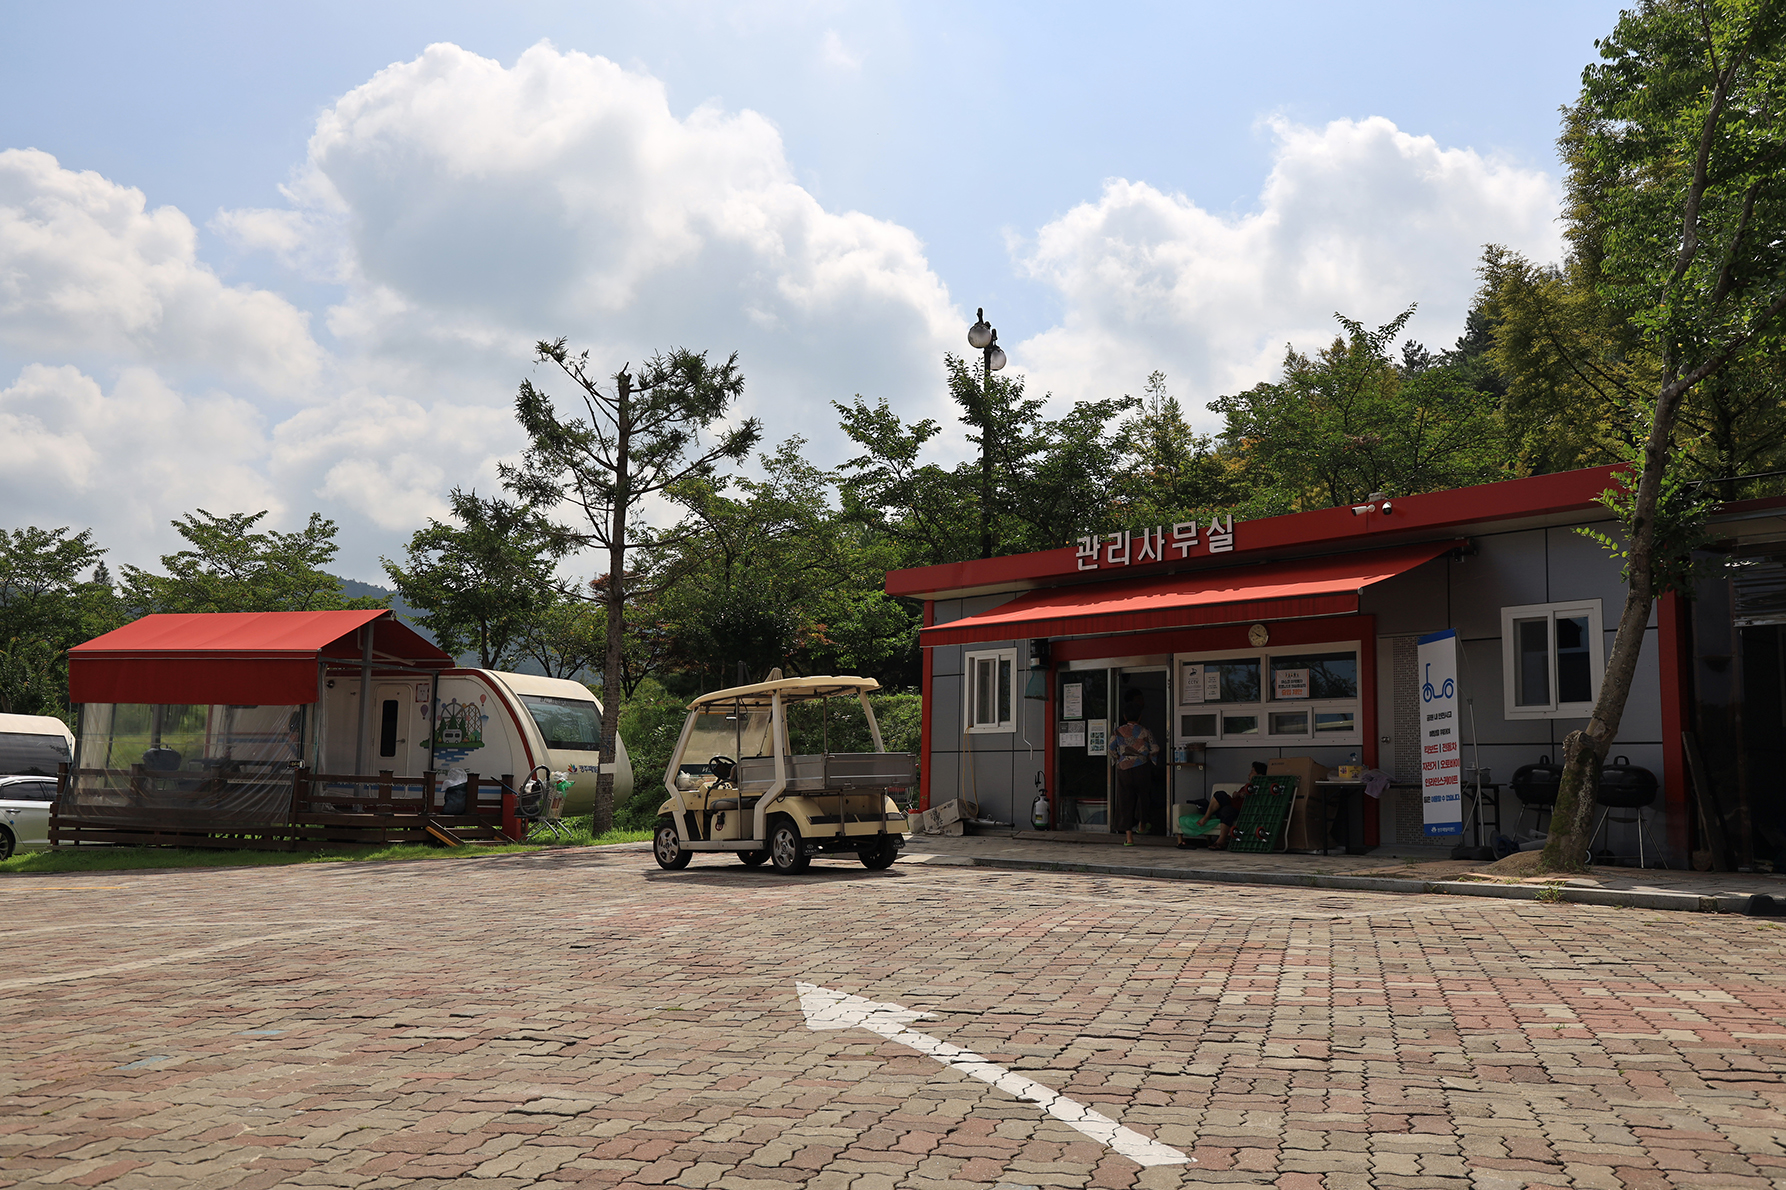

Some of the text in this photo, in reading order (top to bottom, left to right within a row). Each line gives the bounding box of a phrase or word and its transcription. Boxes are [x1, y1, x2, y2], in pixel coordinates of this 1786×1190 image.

[1075, 514, 1234, 571] 관리사무실
[1424, 742, 1457, 754] 킥보드 전동차
[1422, 758, 1461, 771] 자전거 오토바이
[1425, 775, 1458, 787] 인라인스케이트
